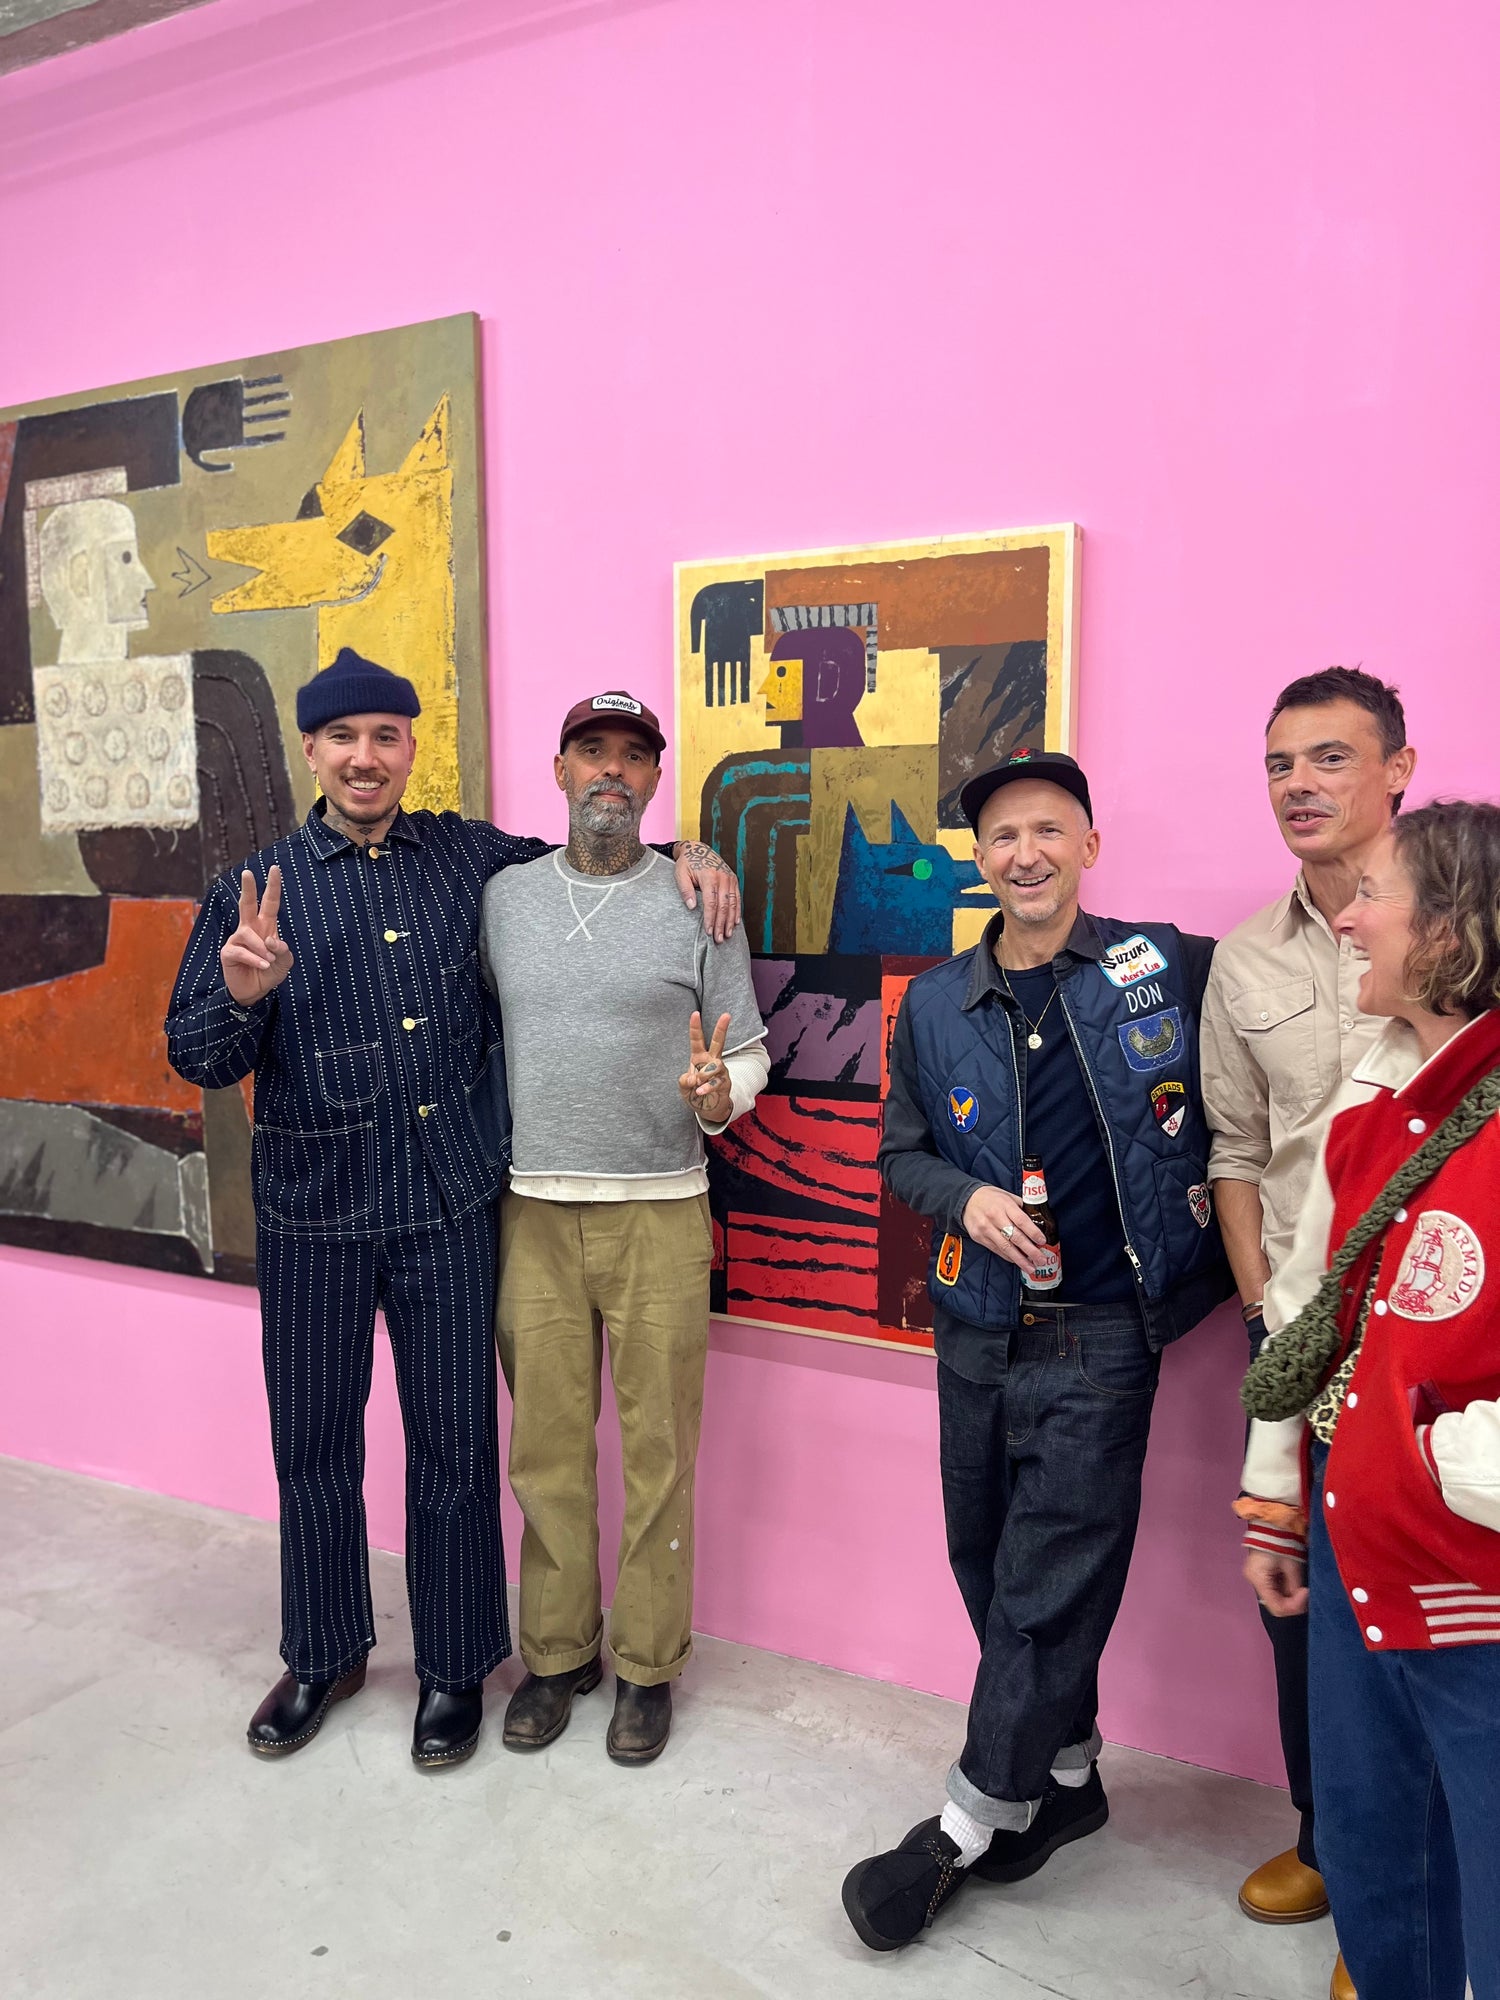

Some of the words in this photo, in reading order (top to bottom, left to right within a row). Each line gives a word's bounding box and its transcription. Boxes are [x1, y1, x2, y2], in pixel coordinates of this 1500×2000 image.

[597, 698, 637, 709] Originals
[1101, 942, 1149, 970] SUZUKI
[1125, 982, 1163, 1013] DON
[1035, 1267, 1053, 1279] PILS
[1447, 1226, 1476, 1304] ARMADA
